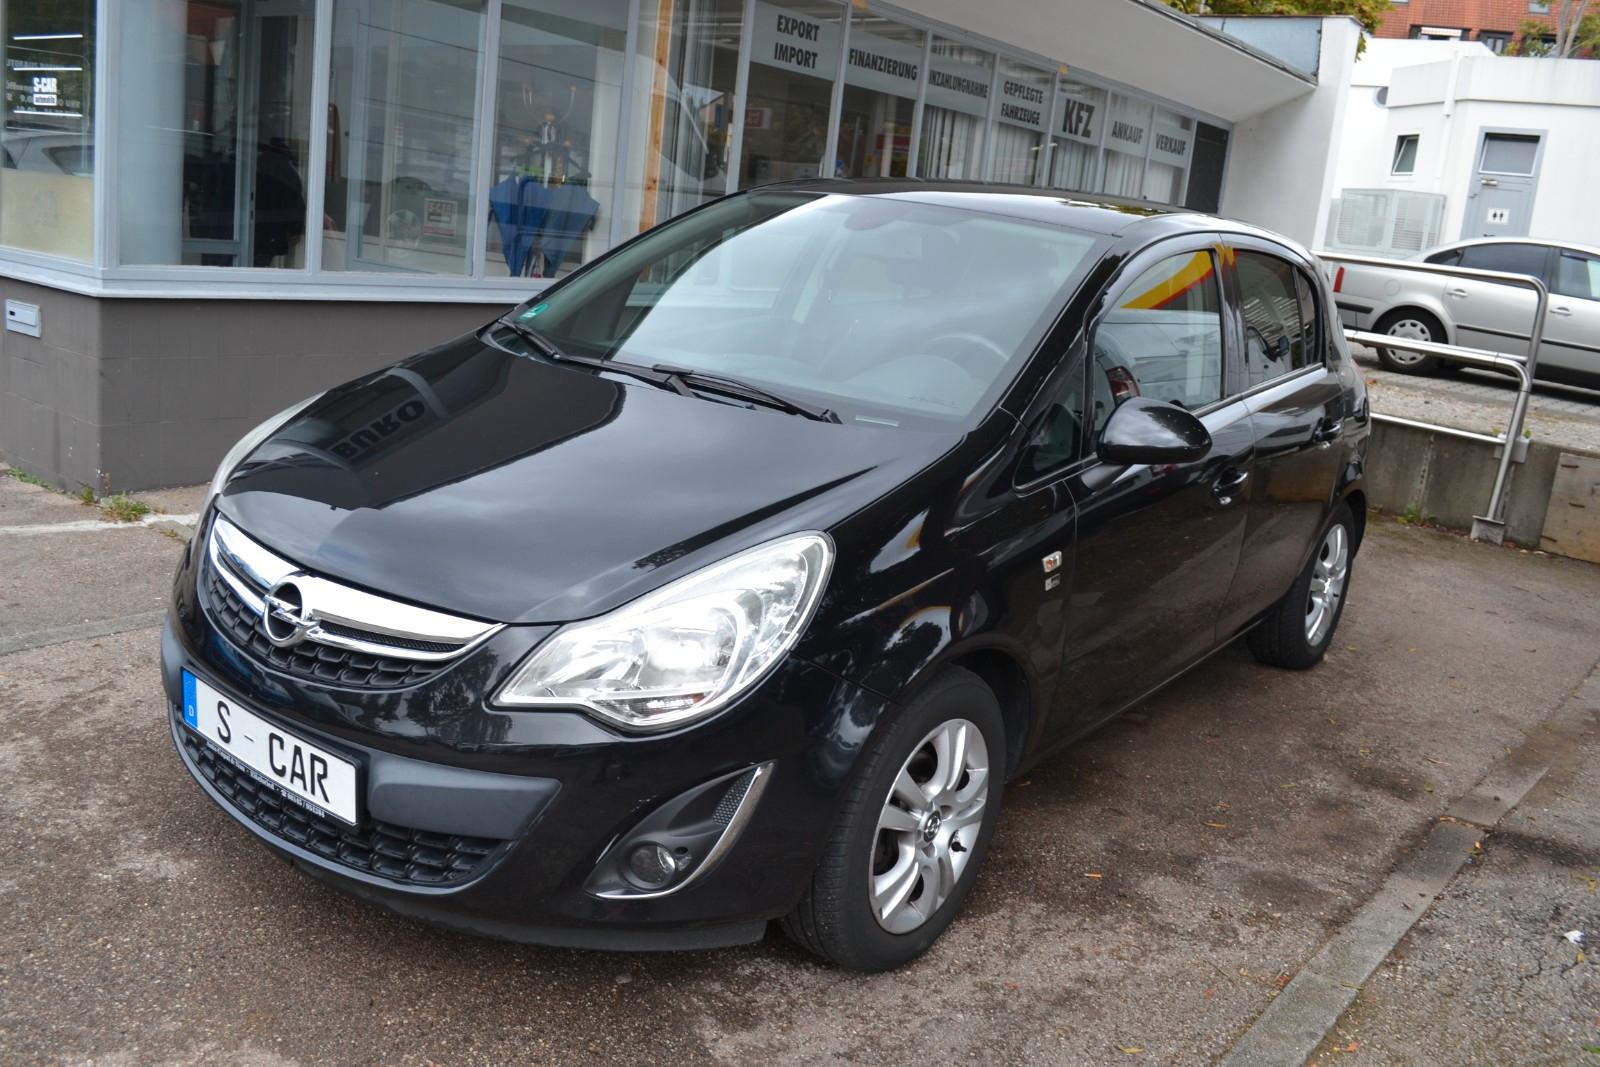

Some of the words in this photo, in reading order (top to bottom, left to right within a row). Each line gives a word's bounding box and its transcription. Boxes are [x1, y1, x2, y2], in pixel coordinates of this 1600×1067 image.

[777, 14, 820, 42] EXPORT
[773, 42, 818, 69] IMPORT
[848, 48, 918, 81] FINANZIERUNG
[33, 77, 57, 93] S-CAR
[1003, 80, 1043, 104] GEPFLEGTE
[1001, 102, 1041, 126] FAHRZEUGE
[1062, 98, 1096, 139] KFZ
[1111, 121, 1144, 144] ANKAUF
[1155, 133, 1187, 156] VERKAUF
[188, 704, 195, 717] D
[217, 700, 231, 744] S
[268, 731, 330, 803] CAR
